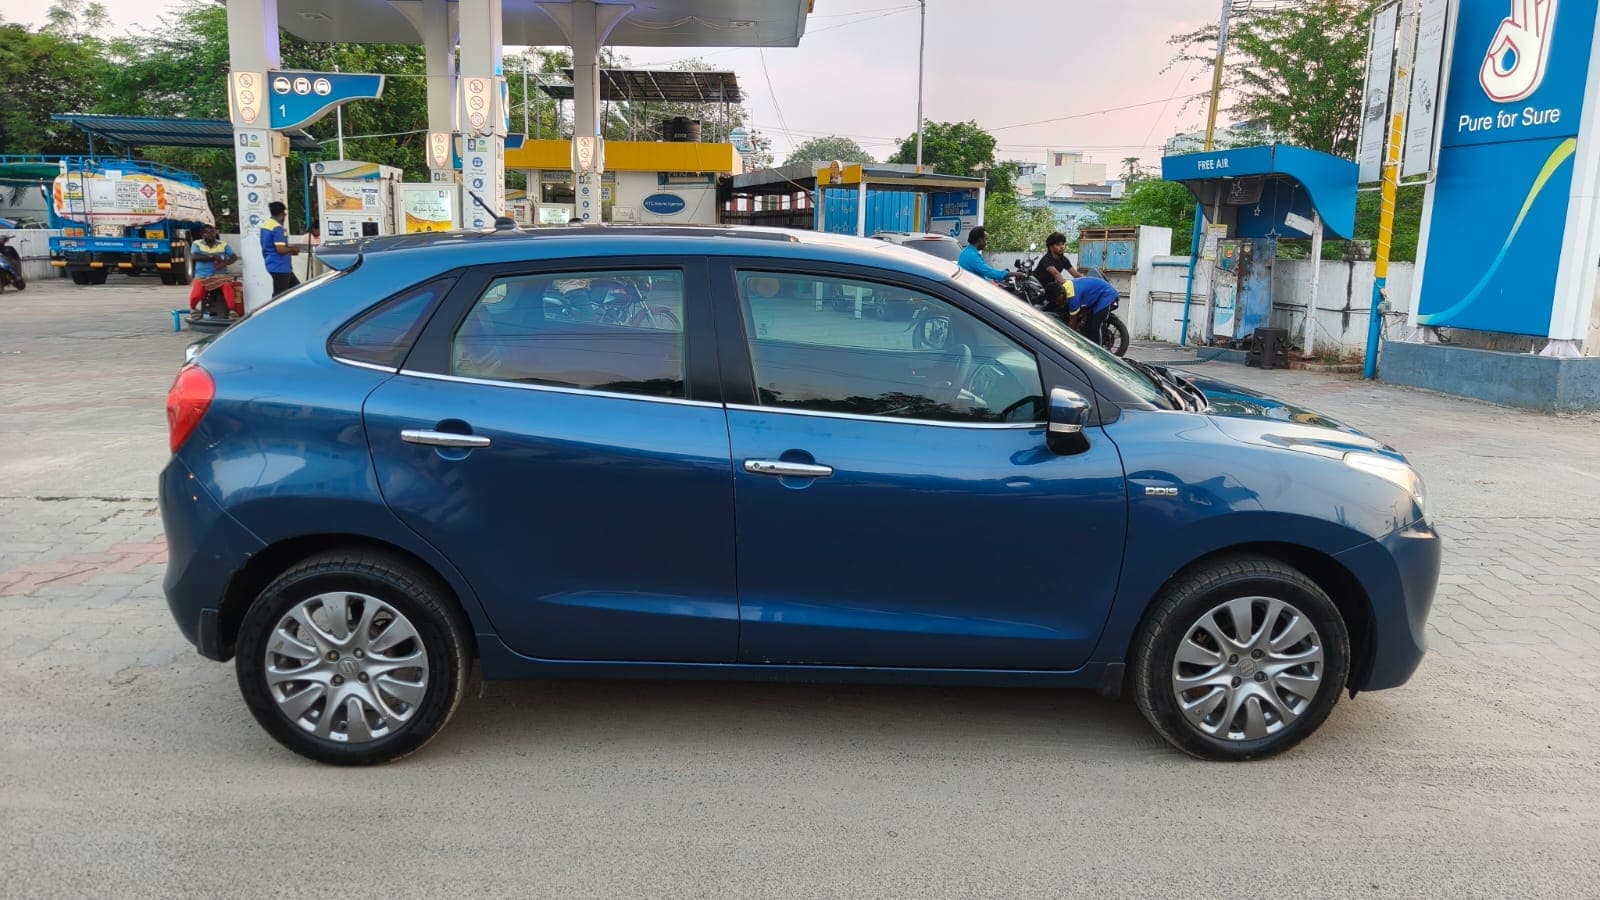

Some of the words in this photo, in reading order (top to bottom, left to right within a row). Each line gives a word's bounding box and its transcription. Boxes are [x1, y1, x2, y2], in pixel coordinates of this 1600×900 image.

[279, 104, 286, 118] 1
[1458, 115, 1493, 133] Pure
[1497, 110, 1518, 129] for
[1521, 106, 1560, 126] Sure
[1197, 160, 1215, 170] FREE
[1216, 158, 1229, 169] AIR
[1145, 486, 1178, 497] DDIS
